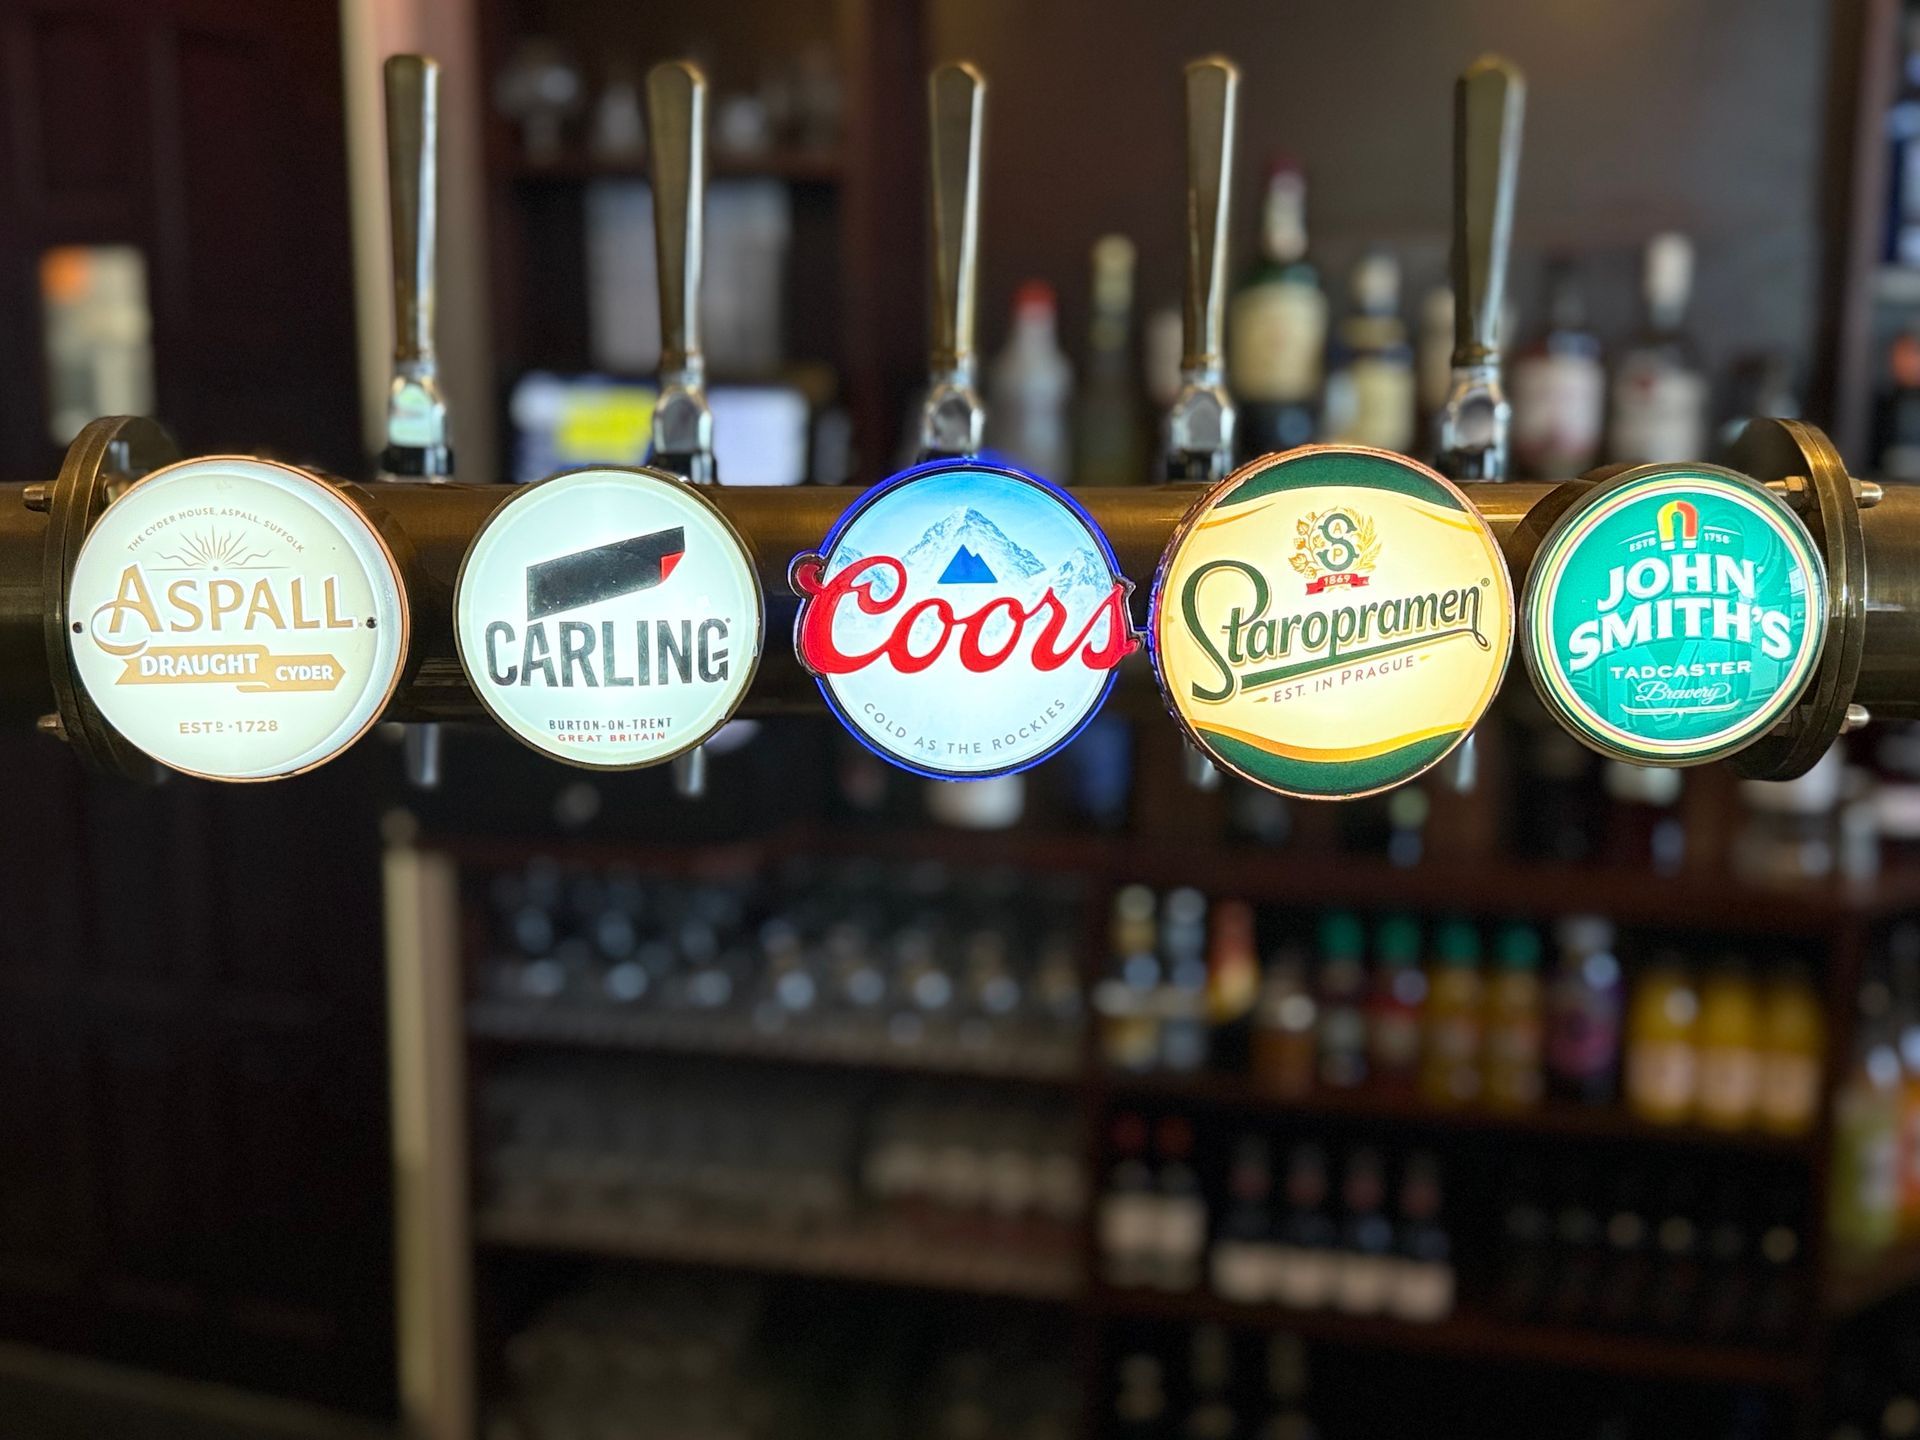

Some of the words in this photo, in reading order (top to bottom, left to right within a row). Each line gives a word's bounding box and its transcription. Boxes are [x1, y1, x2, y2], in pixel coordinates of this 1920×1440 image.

[127, 534, 146, 552] THE
[144, 515, 177, 536] CYDER
[263, 520, 305, 553] SUFFOLK
[1323, 575, 1352, 587] 1869
[1597, 553, 1756, 613] JOHN
[91, 564, 354, 657] ASPALL
[796, 555, 1143, 675] Coors
[1181, 560, 1491, 702] Staropramen
[1568, 597, 1793, 673] SMITH'S
[140, 653, 260, 677] DRAUGHT
[485, 618, 729, 688] CARLING
[1610, 660, 1752, 680] TADCASTER
[275, 665, 335, 681] CYDER
[1273, 683, 1307, 704] EST.
[1315, 676, 1333, 693] IN
[1340, 655, 1415, 686] PRAGUE
[1635, 680, 1732, 704] Brewery
[235, 720, 279, 733] 1728
[549, 717, 673, 731] BURTON-ON-TRENT
[557, 733, 603, 743] GREAT
[609, 731, 666, 743] BRITAIN
[864, 702, 907, 739] COLD
[914, 736, 938, 752] AS
[947, 742, 983, 755] THE
[992, 698, 1067, 751] ROCKIES
